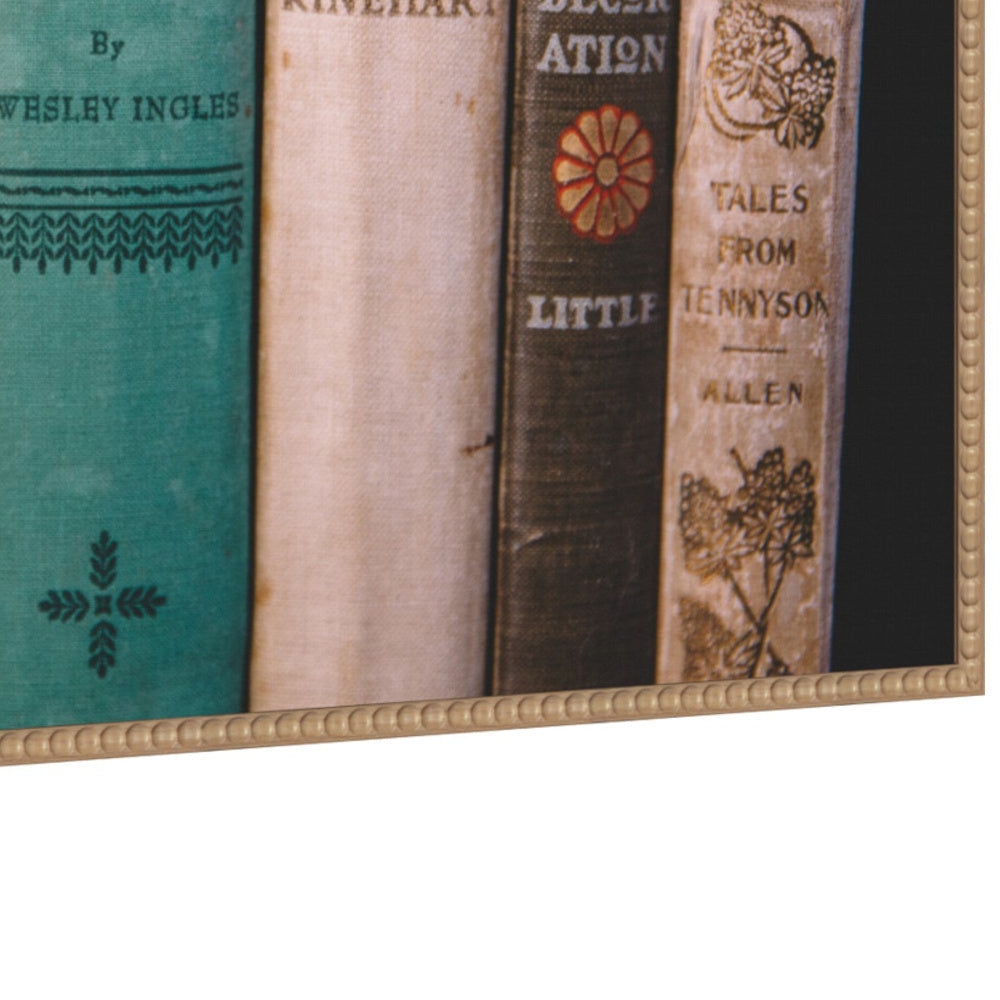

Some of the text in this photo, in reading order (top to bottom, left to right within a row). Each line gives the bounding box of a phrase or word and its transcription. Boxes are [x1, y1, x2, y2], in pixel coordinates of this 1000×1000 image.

[90, 30, 125, 61] By
[537, 33, 668, 75] ATION
[132, 92, 240, 122] INGLES
[710, 181, 808, 215] TALES
[718, 235, 796, 266] FROM
[680, 283, 829, 318] TENNYSON
[702, 379, 804, 405] ALLEN
